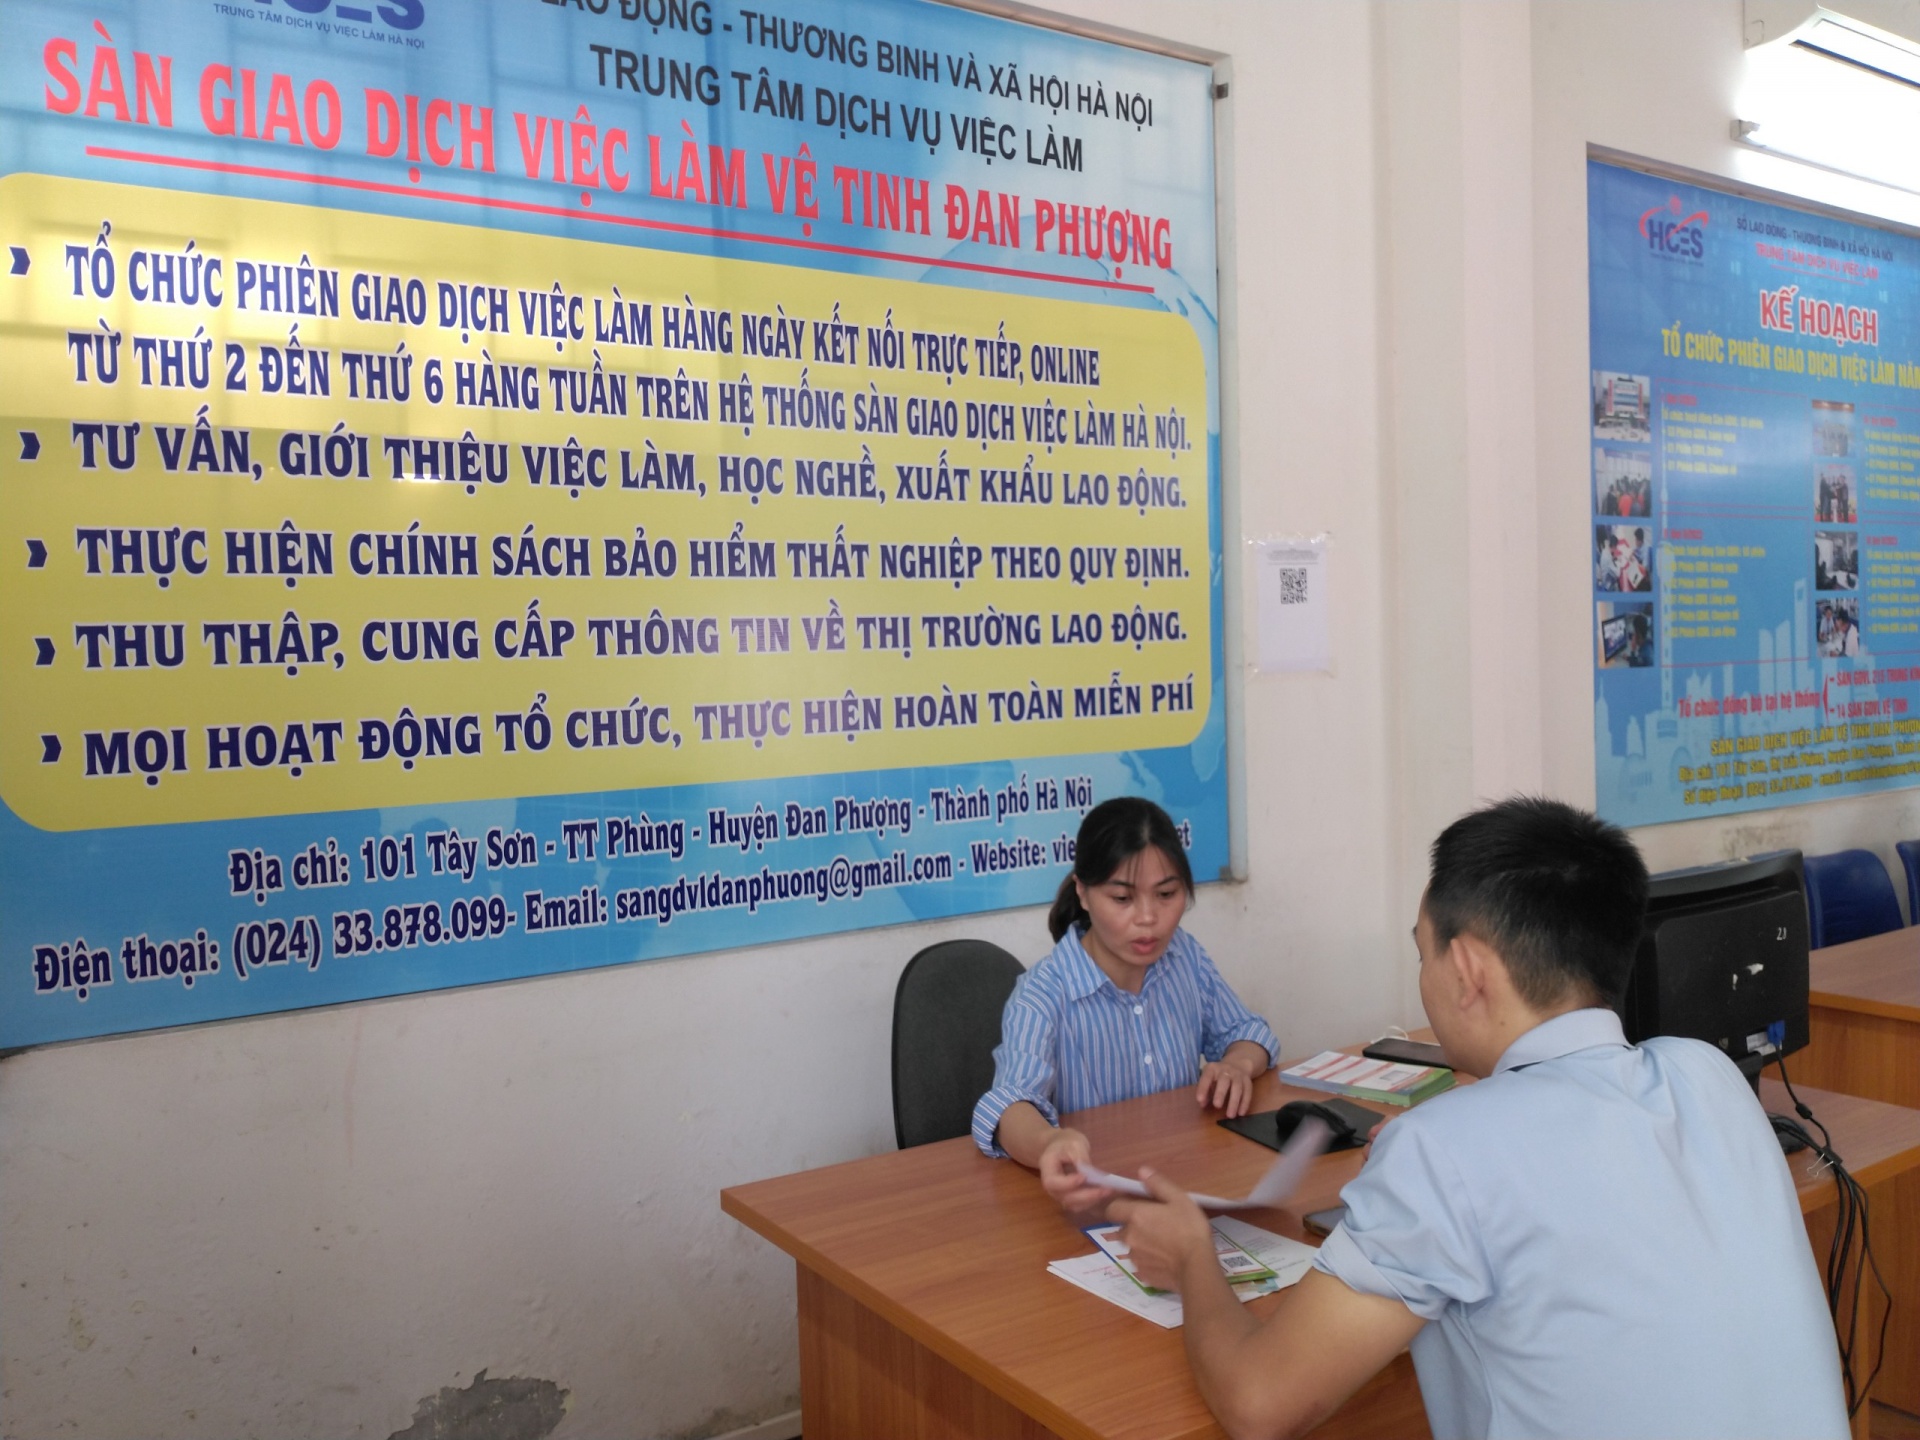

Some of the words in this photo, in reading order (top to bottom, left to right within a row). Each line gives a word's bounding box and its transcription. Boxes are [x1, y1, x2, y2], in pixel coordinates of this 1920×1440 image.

[213, 3, 255, 19] TRUNG
[258, 10, 283, 24] TÂM
[286, 15, 313, 29] DỊCH
[316, 21, 331, 33] VỤ
[333, 22, 359, 38] VIỆC
[362, 29, 386, 42] LÀM
[388, 34, 403, 45] HÀ
[739, 10, 868, 68] THƯƠNG
[876, 42, 939, 85] BINH
[946, 45, 983, 92] VÀ
[988, 60, 1022, 101] XÃ
[1029, 74, 1071, 112] HỘI
[1076, 80, 1110, 118] HÀ
[1115, 87, 1154, 127] NỘI
[43, 20, 174, 128] SÀN
[200, 63, 343, 151] GIAO
[364, 88, 497, 184] DỊCH
[514, 105, 631, 207] VIỆC
[648, 119, 749, 210] LÀM
[762, 142, 820, 238] VỆ
[833, 163, 932, 237] TINH
[944, 184, 1021, 251] ĐAN
[1034, 197, 1173, 279] PHƯỢNG
[590, 44, 721, 105] TRUNG
[731, 67, 804, 122] TÂM
[815, 91, 892, 144] DỊCH
[900, 105, 943, 156] VỤ
[950, 115, 1017, 162] VIỆC
[1026, 129, 1084, 172] LÀM
[1648, 218, 1703, 258] HCES
[65, 221, 116, 299] TỔ
[128, 241, 223, 309] CHỨC
[236, 254, 340, 318] PHIÊN
[351, 274, 427, 326] GIAO
[437, 282, 510, 344] DỊCH
[518, 281, 585, 352] VIỆC
[593, 287, 652, 347] LÀM
[661, 302, 734, 356] HÀNG
[741, 306, 804, 360] NGÀY
[813, 303, 859, 364] KẾT
[866, 308, 905, 369] NỐI
[912, 333, 969, 386] TRỰC
[974, 320, 1025, 387] TIẾP,
[1031, 345, 1101, 387] ONLINE
[1661, 320, 1681, 358] TỔ
[1685, 329, 1724, 364] CHỨC
[1728, 337, 1770, 370] PHIÊN
[1774, 344, 1804, 375] GIAO
[1808, 349, 1838, 382] DỊCH
[1840, 352, 1867, 387] VIỆC
[1870, 355, 1895, 386] LÀM
[1760, 286, 1797, 331] KẾ
[1799, 298, 1878, 346] HOẠCH
[67, 318, 122, 384] TỪ
[134, 327, 212, 389] THỨ
[225, 346, 247, 393] 2
[259, 322, 331, 398] ĐẾN
[342, 341, 412, 402] THỨ
[424, 364, 445, 405] 6
[455, 360, 541, 412] HÀNG
[549, 350, 627, 417] TUẦN
[636, 368, 709, 421] TRÊN
[719, 373, 753, 438] HỆ
[762, 368, 846, 432] THỐNG
[854, 388, 899, 435] SÀN
[906, 397, 959, 440] GIAO
[966, 402, 1016, 452] DỊCH
[1022, 398, 1068, 456] VIỆC
[1074, 401, 1116, 447] LÀM
[1122, 407, 1150, 450] HÀ
[1155, 409, 1192, 454] NỘI.
[72, 423, 139, 470] TƯ
[154, 406, 262, 482] VẤN,
[279, 422, 370, 479] GIỚI
[384, 432, 509, 494] THIỆU
[522, 437, 608, 499] VIỆC
[620, 440, 706, 498] LÀM,
[719, 456, 784, 505] HỌC
[795, 445, 885, 505] NGHỀ,
[896, 449, 970, 502] XUẤT
[980, 453, 1054, 504] KHẨU
[1062, 472, 1110, 507] LAO
[1117, 468, 1187, 516] ĐỘNG.
[76, 528, 208, 588] THỰC
[225, 520, 333, 588] HIỆN
[349, 521, 479, 577] CHÍNH
[492, 525, 590, 577] SÁCH
[604, 527, 678, 578] BẢO
[689, 521, 777, 578] HIỂM
[787, 525, 870, 579] THẤT
[880, 536, 983, 589] NGHIỆP
[991, 546, 1061, 580] THEO
[1069, 547, 1118, 586] QUY
[1125, 546, 1190, 588] ĐỊNH.
[75, 624, 185, 669] THU
[204, 611, 345, 676] THẬP,
[361, 619, 479, 661] CUNG
[493, 599, 575, 659] CẤP
[588, 608, 719, 656] THÔNG
[731, 617, 792, 654] TIN
[802, 600, 846, 652] VỀ
[856, 616, 911, 659] THỊ
[922, 605, 1042, 649] TRƯỜNG
[1051, 613, 1102, 644] LAO
[1111, 605, 1187, 650] ĐỘNG.
[84, 729, 188, 786] MỌI
[207, 721, 343, 777] HOẠT
[358, 708, 482, 771] ĐỘNG
[496, 692, 553, 753] TỔ
[565, 697, 682, 749] CHỨC,
[695, 700, 792, 748] THỰC
[803, 690, 883, 743] HIỆN
[895, 689, 978, 729] HOÀN
[988, 681, 1065, 723] TOÀN
[1073, 672, 1142, 717] MIỄN
[1151, 676, 1194, 713] PHÍ
[229, 850, 283, 904] Địa
[292, 839, 349, 888] chỉ:
[361, 837, 417, 881] 101
[426, 832, 478, 882] Tây
[487, 828, 538, 869] Sơn
[562, 822, 599, 861] TT
[606, 817, 685, 860] Phùng
[708, 803, 780, 855] Huyện
[785, 802, 828, 838] Đan
[835, 797, 913, 843] Phượng
[931, 784, 991, 824] Thành
[996, 774, 1031, 824] phố
[1035, 780, 1059, 812] Hà
[1064, 776, 1094, 811] Nội
[34, 945, 112, 999] Điện
[122, 932, 221, 985] thoại:
[233, 916, 322, 980] (024)
[525, 889, 609, 931] Email:
[616, 849, 953, 926] sangdvldanphuong@gmail.com
[971, 834, 1047, 876] Website:
